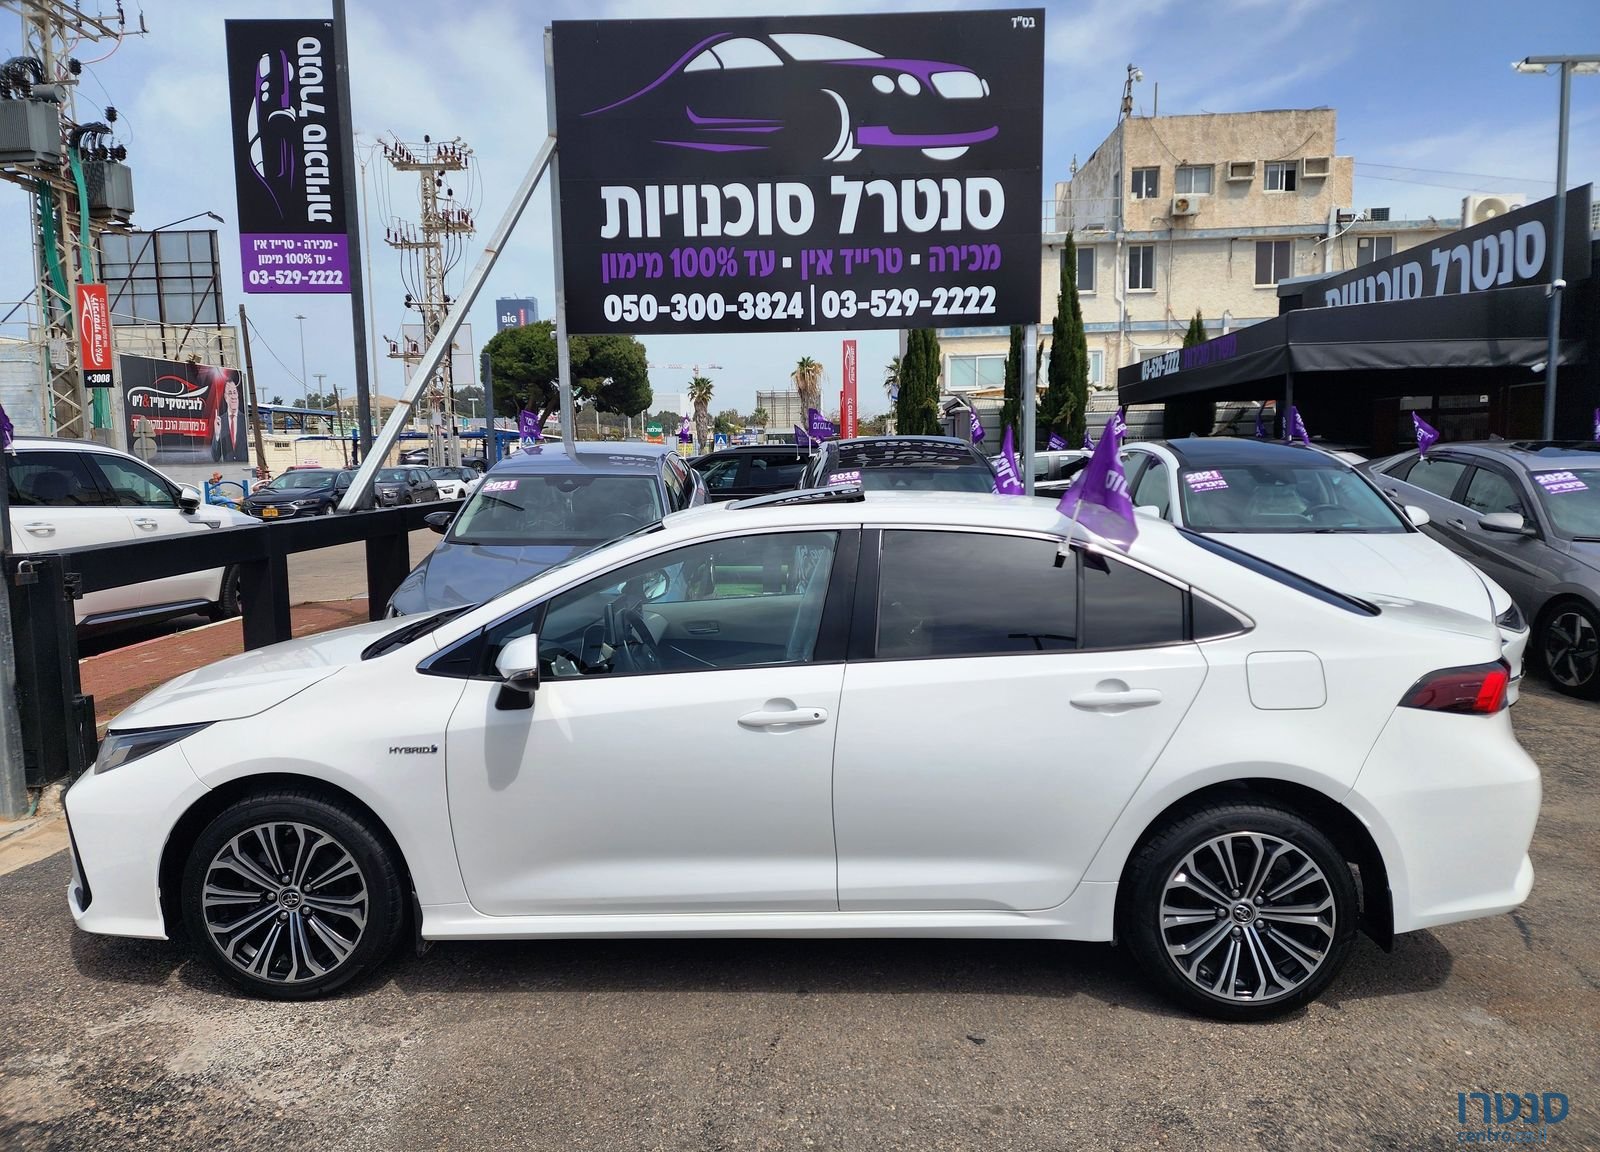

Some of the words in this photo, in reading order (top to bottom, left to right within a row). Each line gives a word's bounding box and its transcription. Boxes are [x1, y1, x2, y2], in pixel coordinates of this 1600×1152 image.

[297, 36, 326, 118] סנטרל
[302, 123, 333, 223] סוכנויות
[600, 182, 815, 240] סוכנויות
[830, 175, 1006, 235] סנטרל
[253, 239, 268, 251] אין
[268, 239, 295, 250] טרייד
[285, 252, 313, 265] 100%
[304, 239, 333, 250] מכירה
[928, 243, 1002, 273] מכירה
[1431, 220, 1547, 297] סנטרל
[258, 254, 283, 266] מימון
[313, 254, 326, 265] עד
[601, 252, 664, 284] מימון
[669, 246, 739, 278] 100%
[743, 249, 776, 277] עד
[801, 248, 834, 281] אין
[839, 247, 904, 275] טרייד
[248, 269, 343, 285] 03-529-2222
[603, 291, 804, 323] 050-300-3824
[821, 285, 997, 319] 03-529-2222
[1141, 350, 1180, 381] 03-529-2222
[482, 480, 519, 492] 2021
[389, 746, 431, 754] HYBRID
